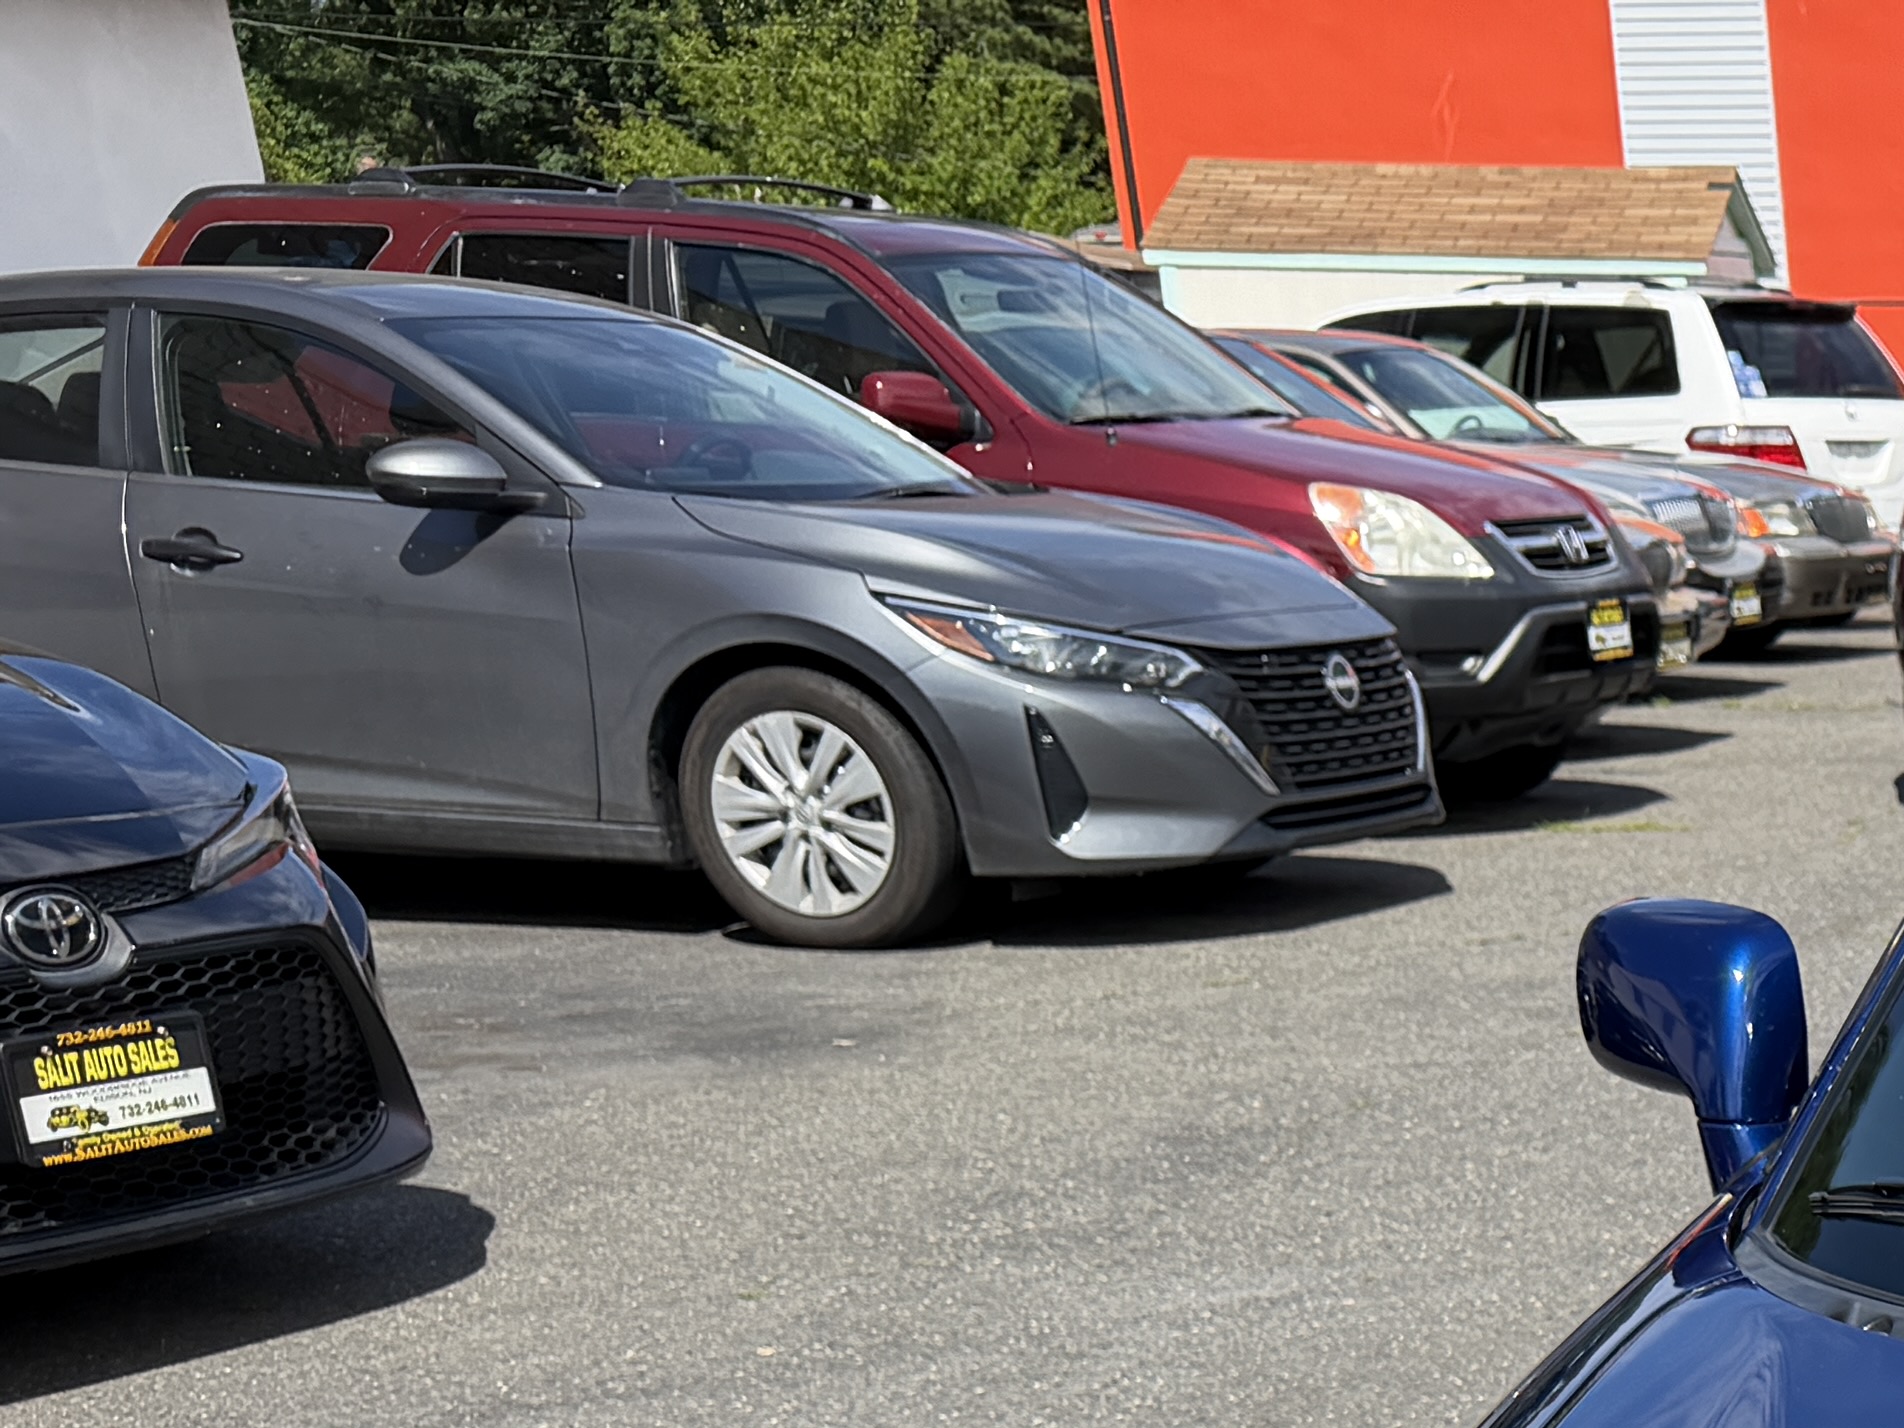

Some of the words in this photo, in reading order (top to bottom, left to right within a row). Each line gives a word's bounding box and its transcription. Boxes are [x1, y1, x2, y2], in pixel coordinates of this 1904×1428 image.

[33, 1051, 81, 1090] SALIT
[83, 1044, 128, 1082] AUTO
[127, 1036, 180, 1075] SALES
